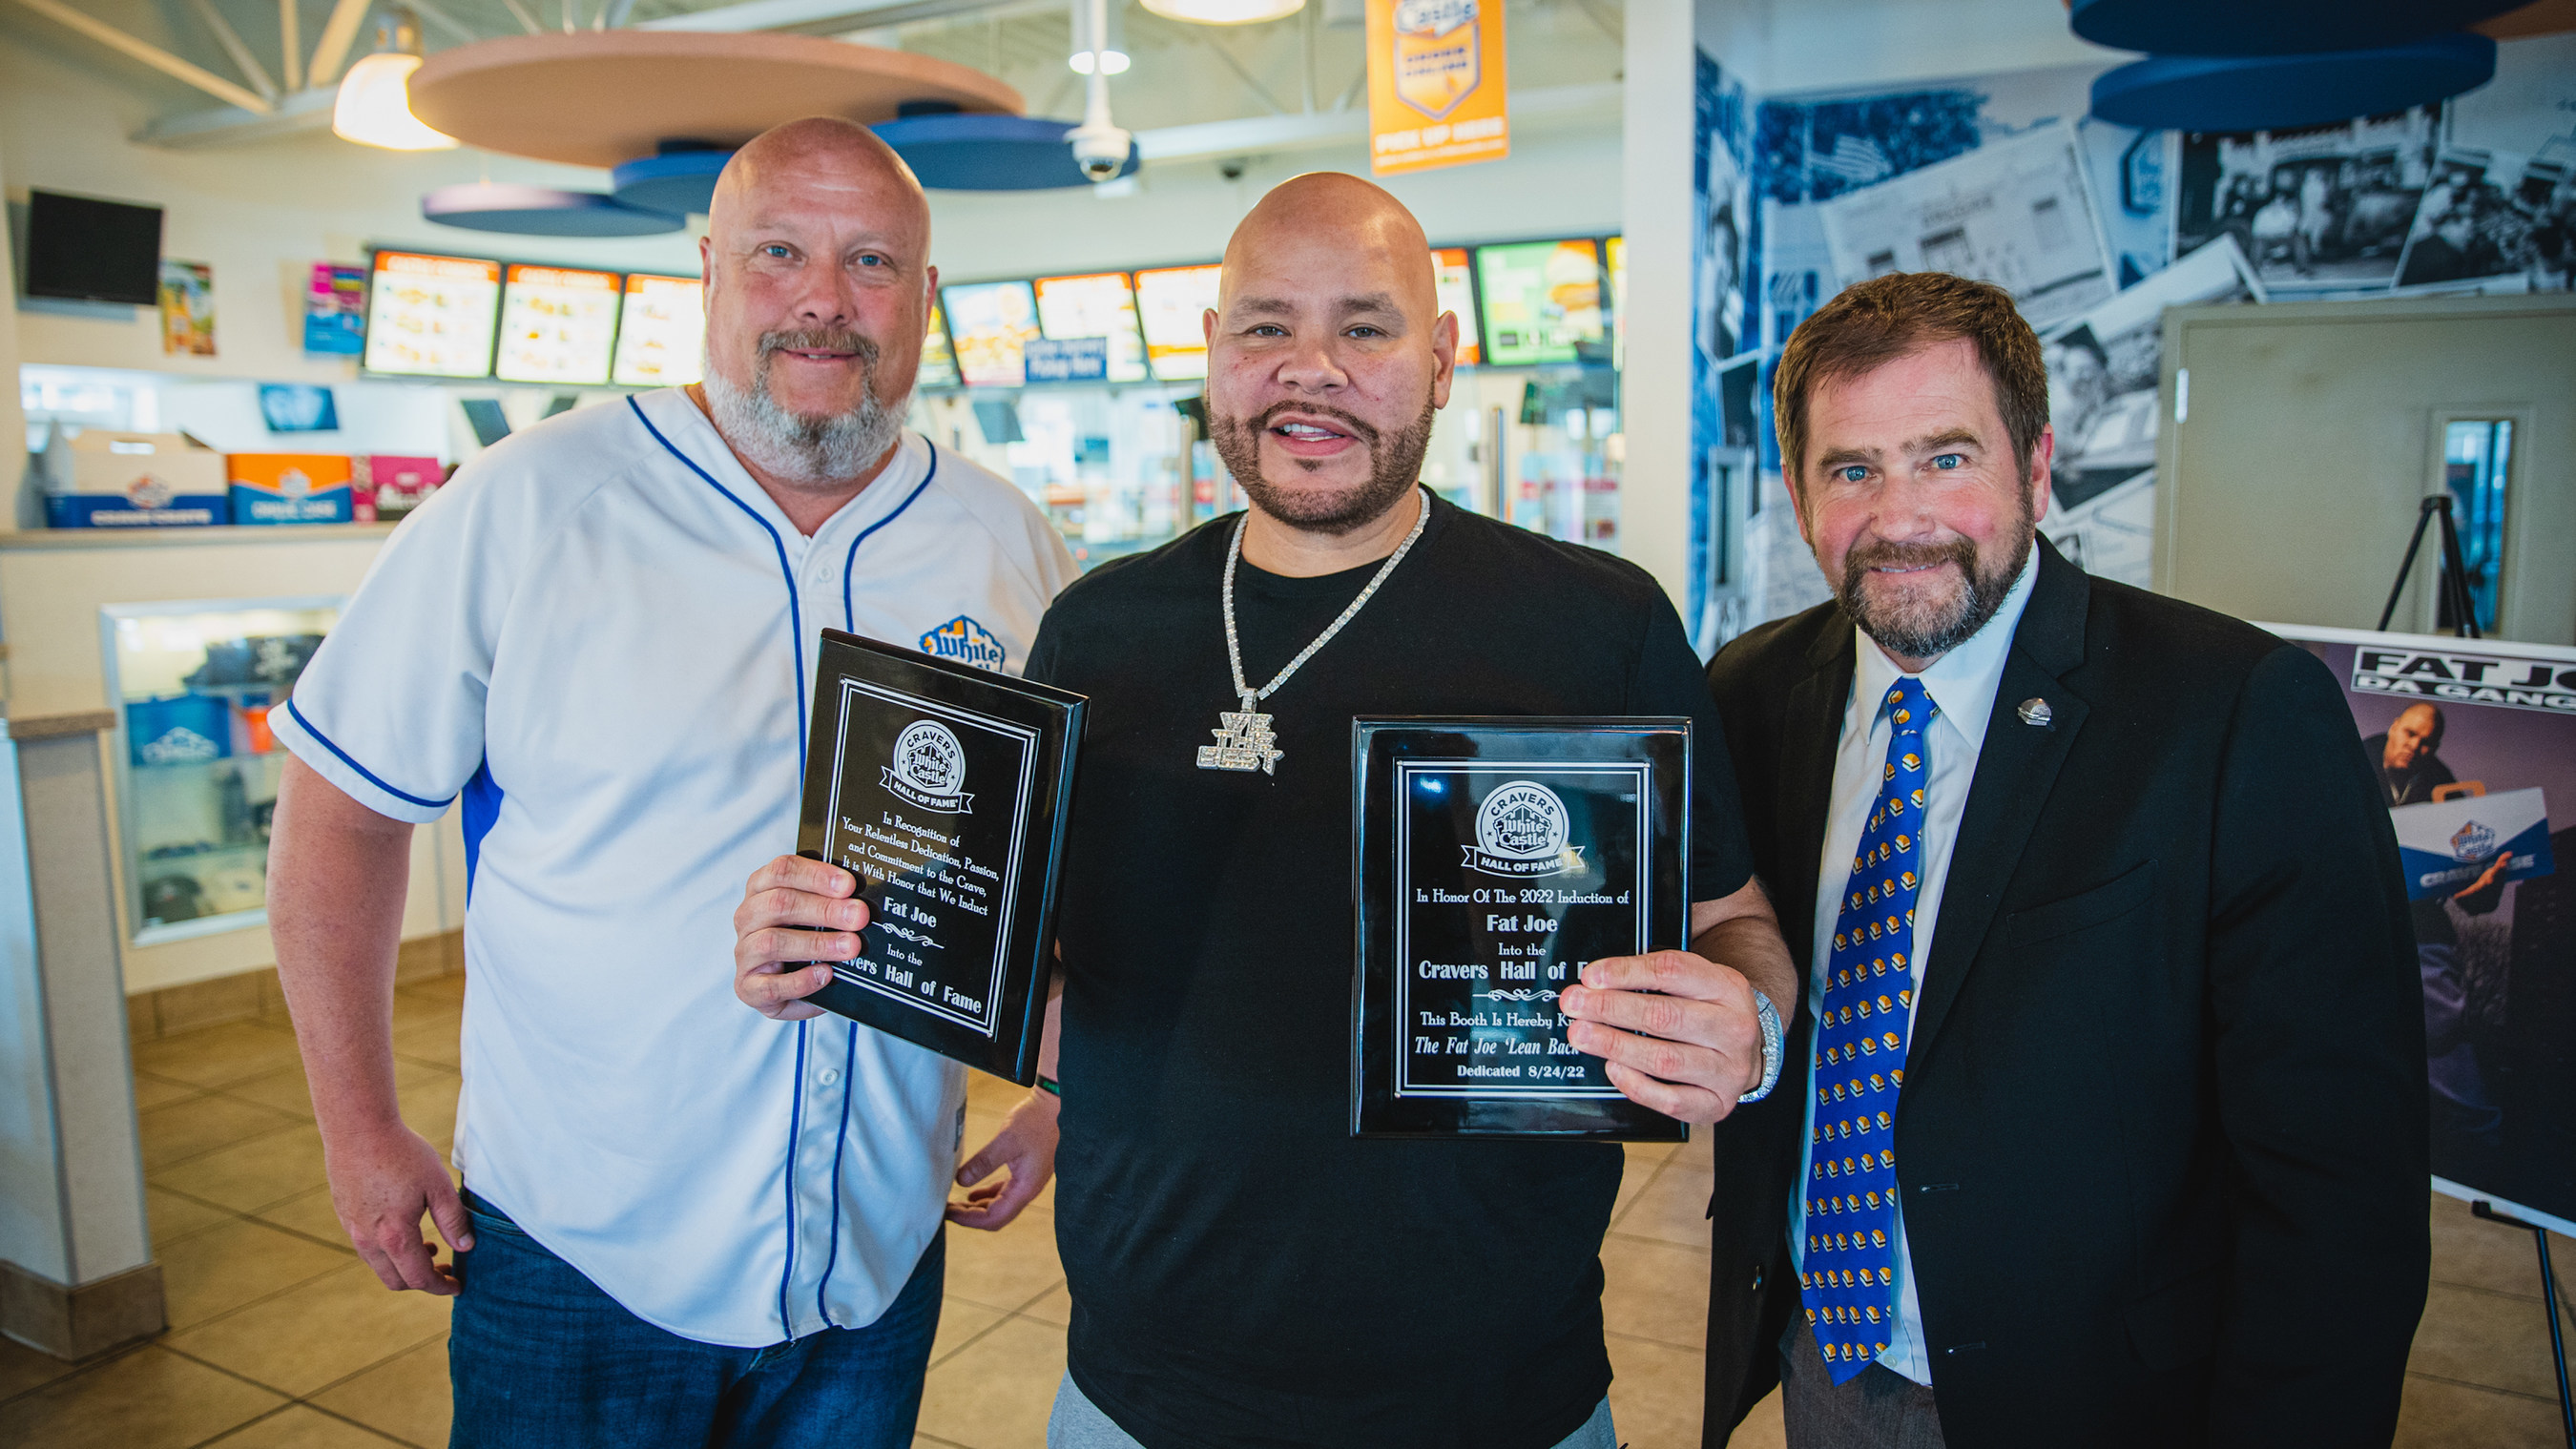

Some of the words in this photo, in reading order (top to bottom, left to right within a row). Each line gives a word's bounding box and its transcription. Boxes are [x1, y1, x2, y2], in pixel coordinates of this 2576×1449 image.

[934, 633, 998, 663] White
[2360, 652, 2500, 681] FAT
[2357, 675, 2423, 694] DA
[906, 731, 956, 759] CRAVERS
[912, 754, 946, 773] White
[910, 764, 946, 784] Castle
[893, 780, 916, 800] HALL
[917, 794, 930, 804] OF
[1490, 792, 1555, 817] CRAVERS
[883, 811, 892, 825] In
[894, 814, 947, 843] Recognition
[949, 835, 961, 848] of
[1501, 818, 1546, 835] White
[842, 816, 862, 835] Your
[864, 823, 908, 850] Relentless
[910, 839, 963, 869] Dedication,
[964, 857, 1000, 882] Passion,
[1499, 832, 1547, 846] Castle
[848, 842, 865, 855] and
[867, 844, 924, 875] Commitment
[926, 867, 937, 879] to
[939, 871, 954, 885] the
[956, 876, 987, 898] Crave,
[1481, 857, 1512, 872] HALL
[1513, 862, 1529, 873] OF
[1530, 858, 1563, 872] FAME
[842, 855, 850, 868] It
[852, 861, 861, 872] is
[862, 861, 885, 880] With
[887, 870, 916, 892] Honor
[917, 882, 937, 899] that
[939, 887, 957, 905] We
[958, 895, 988, 917] Induct
[1416, 888, 1428, 902] In
[1432, 888, 1469, 903] Honor
[1472, 888, 1490, 903] Of
[1493, 889, 1516, 903] The
[1520, 888, 1553, 903] 2022
[1557, 889, 1613, 904] Induction
[1616, 889, 1630, 904] of
[883, 896, 907, 918] Fat
[910, 906, 937, 928] Joe
[1486, 914, 1519, 932] Fat
[1523, 914, 1558, 932] Joe
[886, 943, 905, 961] Into
[907, 952, 924, 966] the
[1498, 942, 1522, 956] Into
[1527, 942, 1547, 956] the
[1419, 960, 1488, 980] Cravers
[1500, 961, 1536, 980] Hall
[1548, 961, 1567, 980] of
[884, 963, 914, 988] Hall
[921, 980, 937, 997] of
[943, 984, 983, 1014] Fame
[1420, 1011, 1445, 1026] This
[1449, 1012, 1487, 1026] Booth
[1491, 1012, 1502, 1026] Is
[1506, 1012, 1553, 1029] Hereby
[1415, 1036, 1439, 1055] The
[1445, 1037, 1469, 1055] Fat
[1474, 1037, 1497, 1055] Joe
[1457, 1065, 1521, 1078] Dedicated
[1527, 1066, 1586, 1079] 8/24/22
